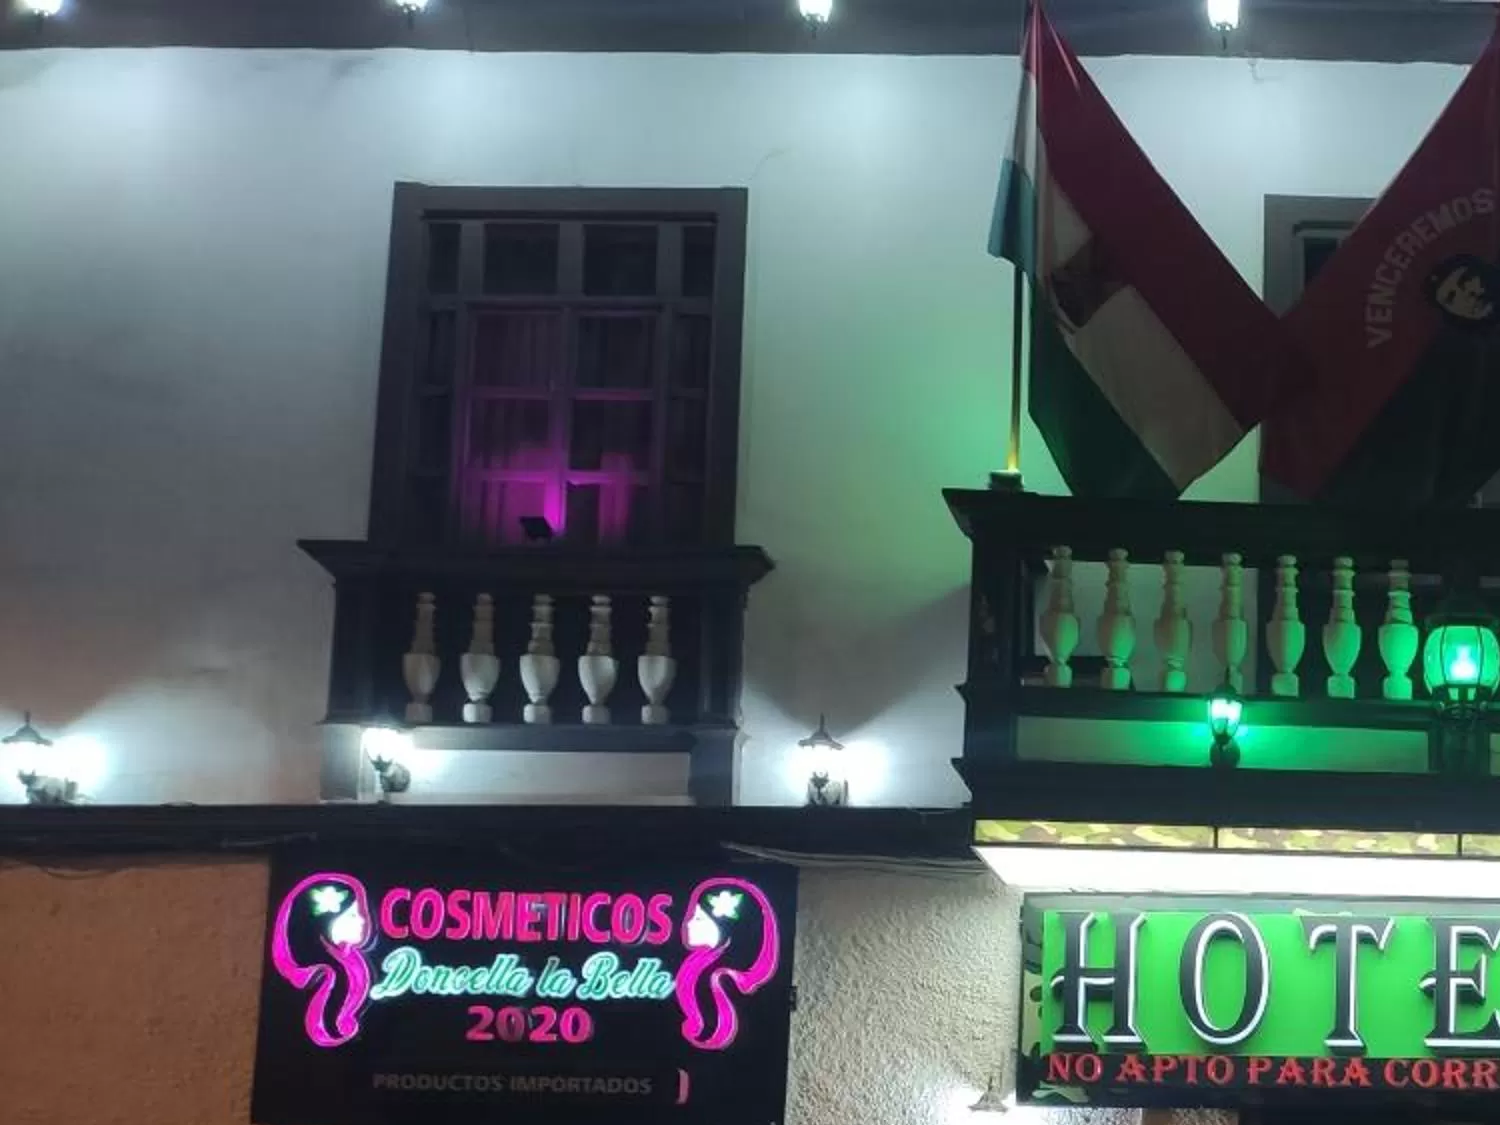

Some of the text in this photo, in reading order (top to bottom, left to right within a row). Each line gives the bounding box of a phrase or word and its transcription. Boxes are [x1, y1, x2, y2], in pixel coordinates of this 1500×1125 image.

[1364, 188, 1495, 349] VENCEREMOS
[379, 887, 673, 945] COSMETICOS
[370, 946, 535, 1000] Doncella
[575, 951, 677, 1000] Bella
[465, 1004, 595, 1043] 2020
[372, 1072, 653, 1096] PRODUCTOS IMPORTADOS
[1046, 1053, 1101, 1083] NO
[1115, 1055, 1235, 1086] APTO
[1247, 1056, 1372, 1088] PARA
